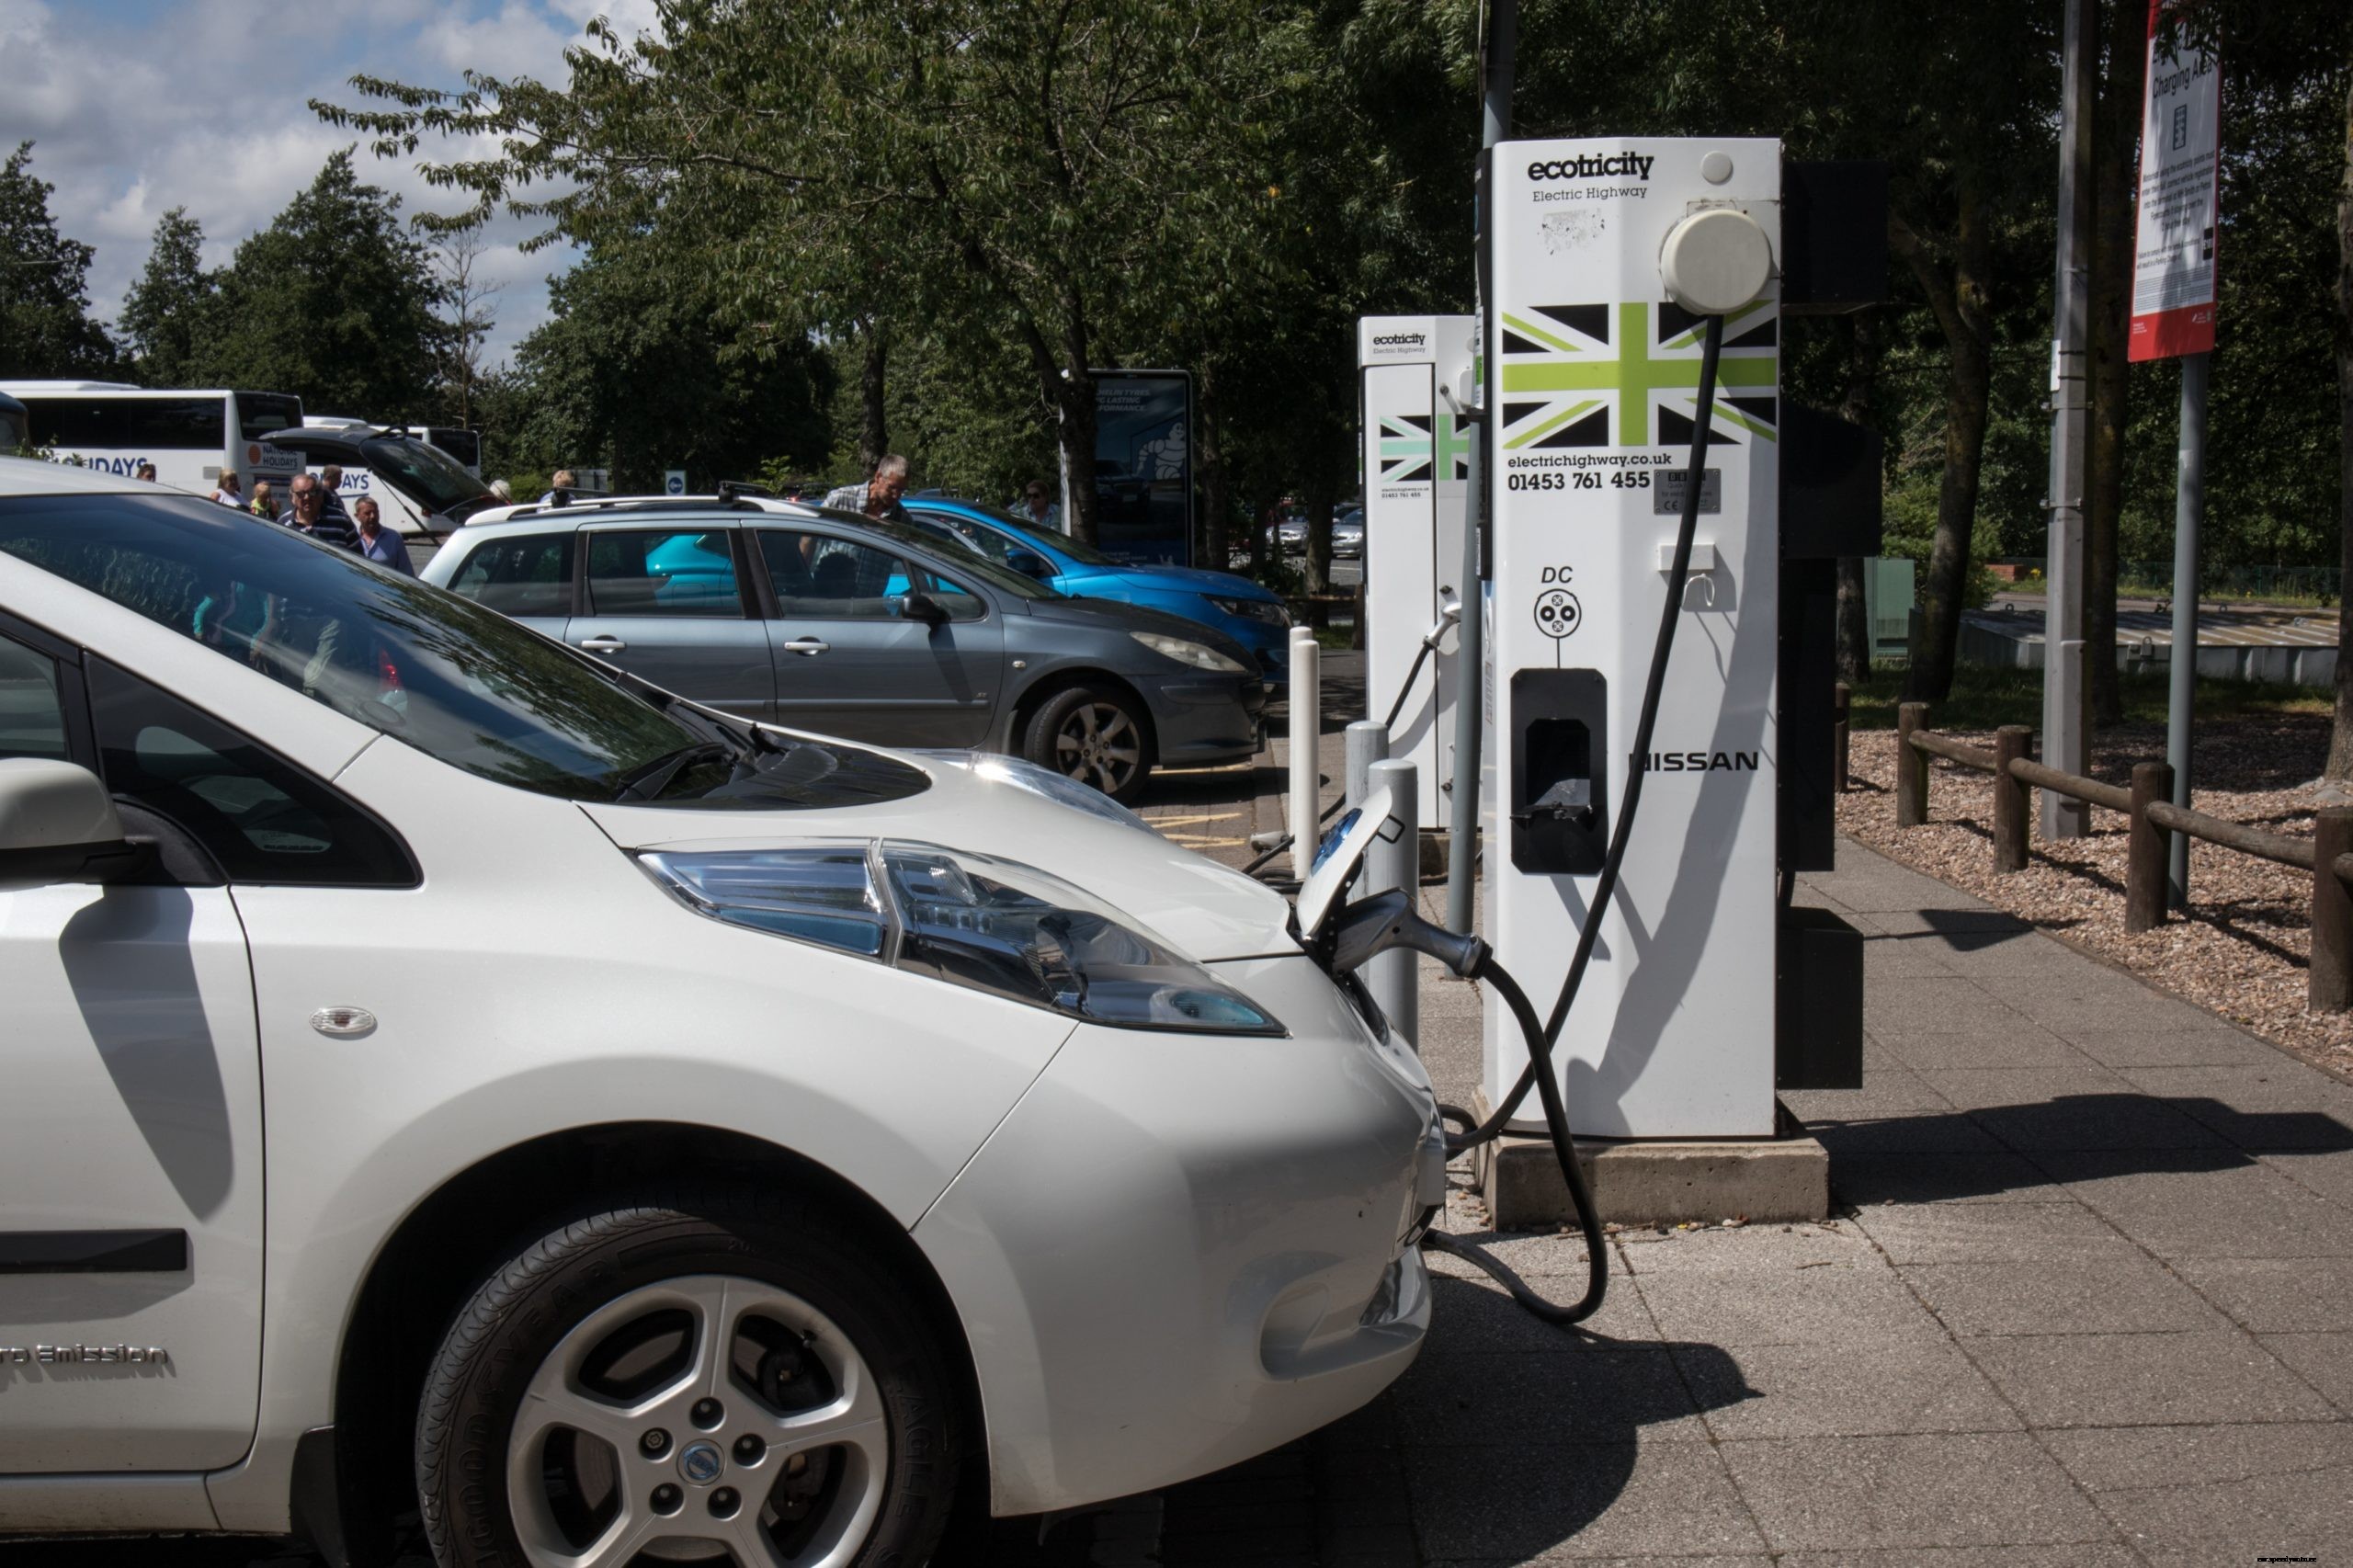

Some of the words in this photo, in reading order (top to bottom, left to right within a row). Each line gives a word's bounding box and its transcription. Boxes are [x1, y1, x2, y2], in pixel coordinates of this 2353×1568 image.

[2152, 67, 2190, 99] Charging
[1528, 152, 1654, 181] ecotricity
[1532, 188, 1583, 202] Electric
[1586, 186, 1648, 199] Highway
[1373, 333, 1426, 346] ecotricity
[1397, 347, 1426, 355] Highway
[262, 457, 298, 468] HOLIDAYS
[1507, 453, 1672, 469] electrichighway.co.uk
[1507, 472, 1565, 491] 01453
[1573, 472, 1603, 490] 761
[1610, 471, 1651, 488] 455
[1541, 566, 1574, 584] DC
[36, 1343, 169, 1365] Emission
